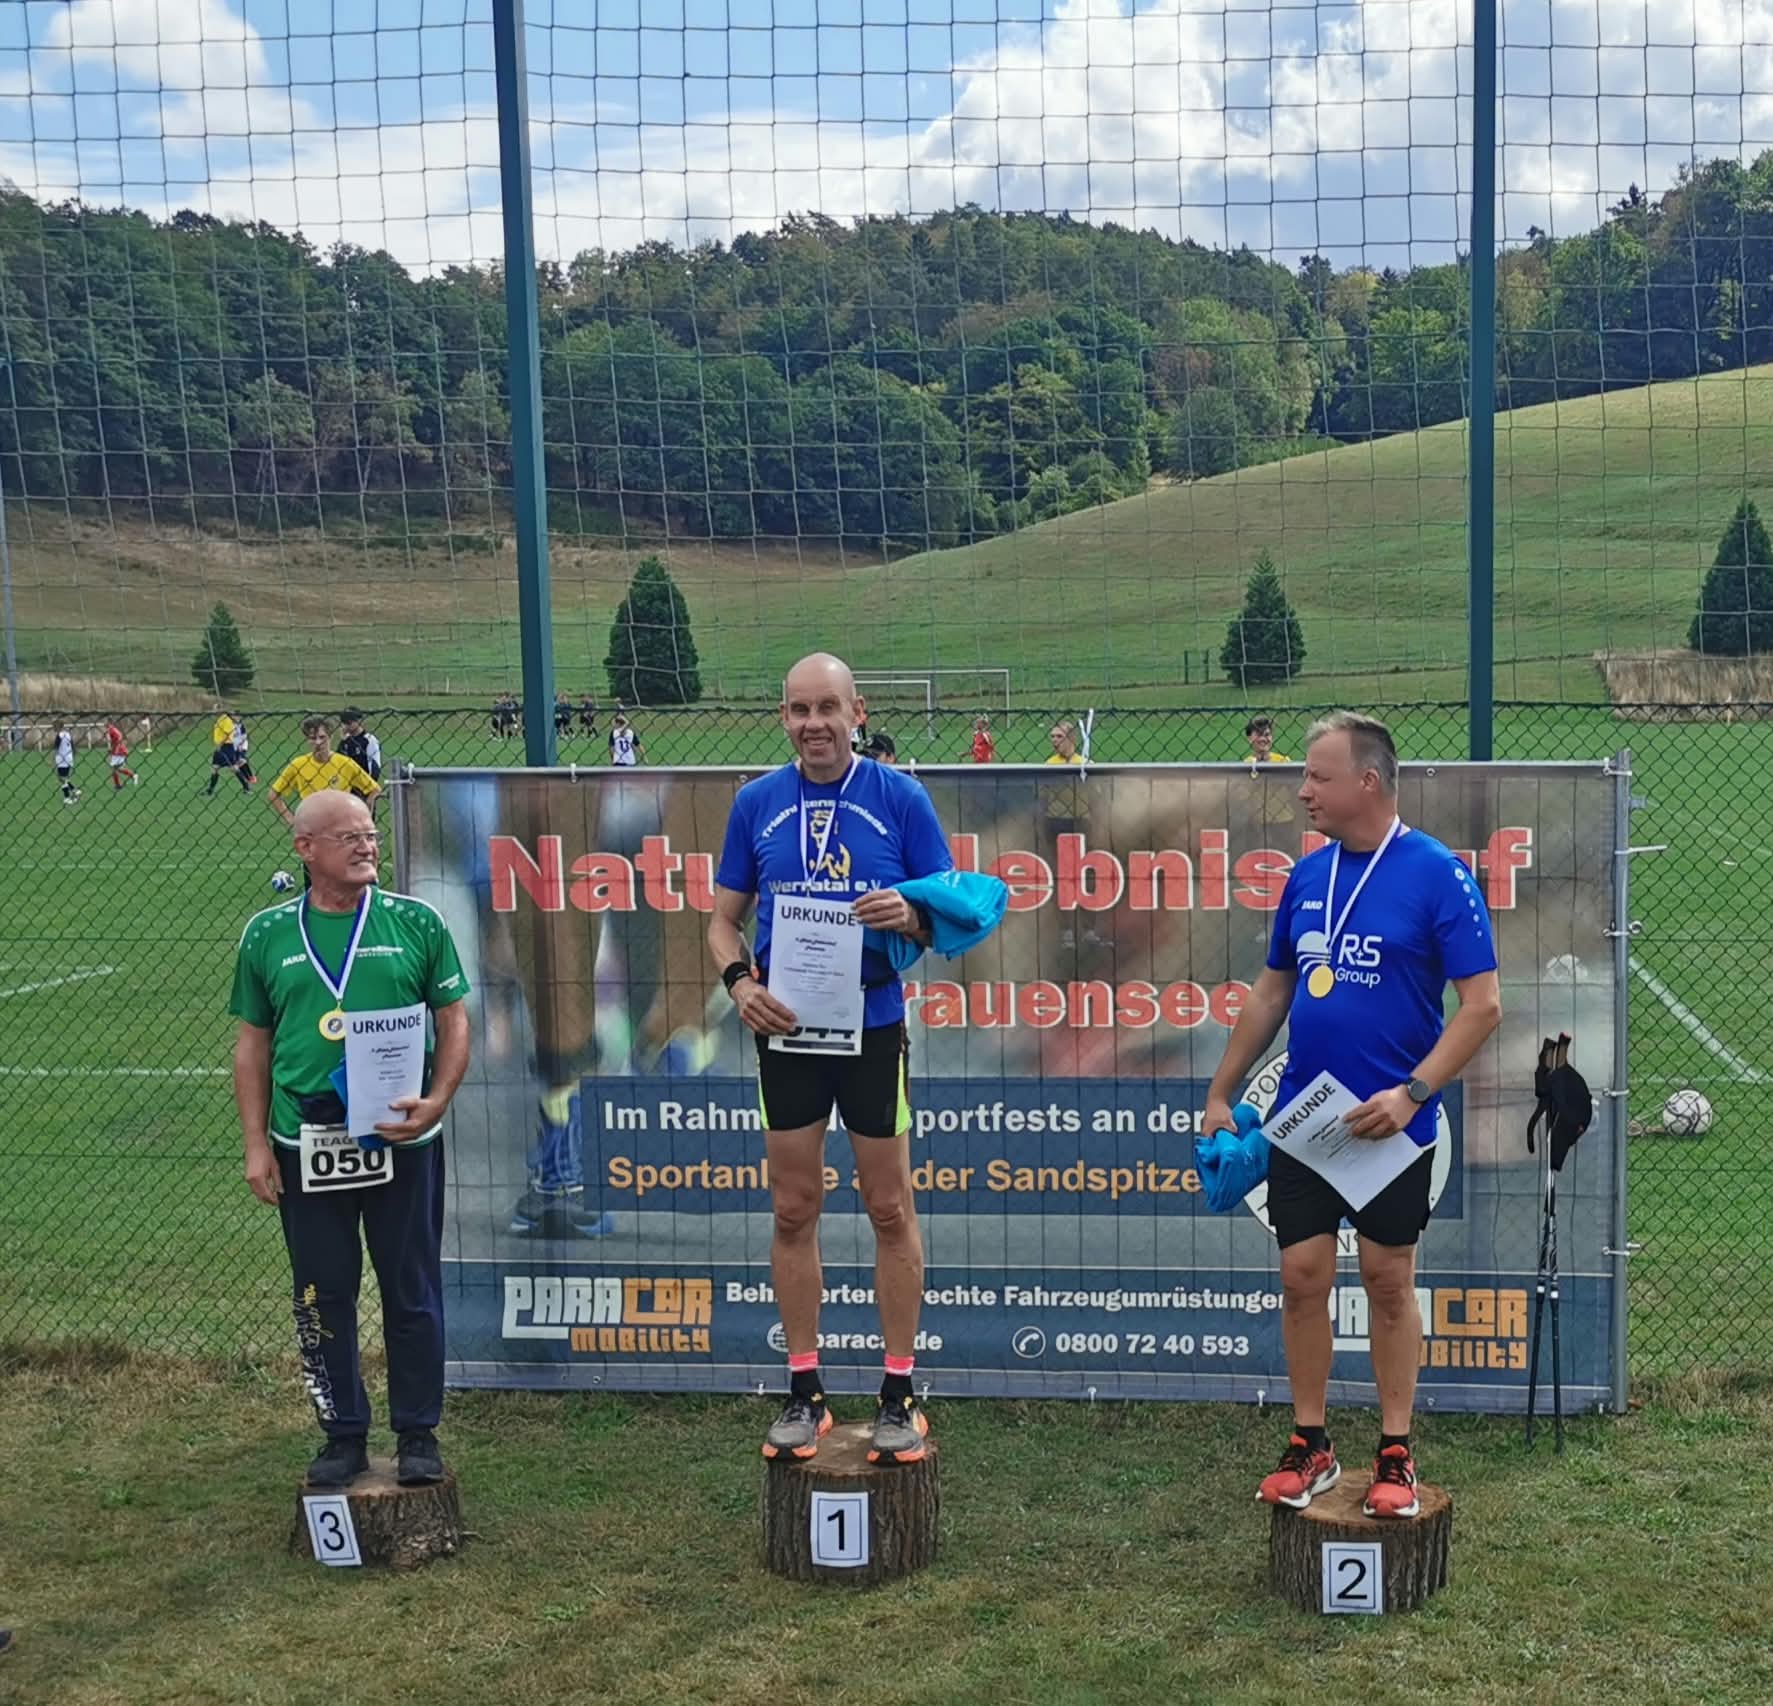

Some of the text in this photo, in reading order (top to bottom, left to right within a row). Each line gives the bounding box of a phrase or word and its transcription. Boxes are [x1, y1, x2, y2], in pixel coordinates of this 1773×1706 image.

[781, 905, 857, 926] URKUNDE
[1302, 900, 1323, 910] JAKO
[282, 953, 306, 967] JAKO
[1335, 967, 1381, 989] Group
[353, 1013, 421, 1034] URKUNDE
[605, 1101, 1206, 1138] Im Rahm portfests an der
[1272, 1082, 1337, 1140] URKUNDE
[311, 1149, 385, 1176] 050
[911, 1160, 975, 1192] der
[986, 1159, 1202, 1199] Sandspitze
[502, 1276, 712, 1339] PARACAR
[1055, 1333, 1249, 1356] 0800 72 40 593
[320, 1511, 345, 1550] 3
[827, 1509, 845, 1551] 1
[1337, 1558, 1368, 1600] 2
